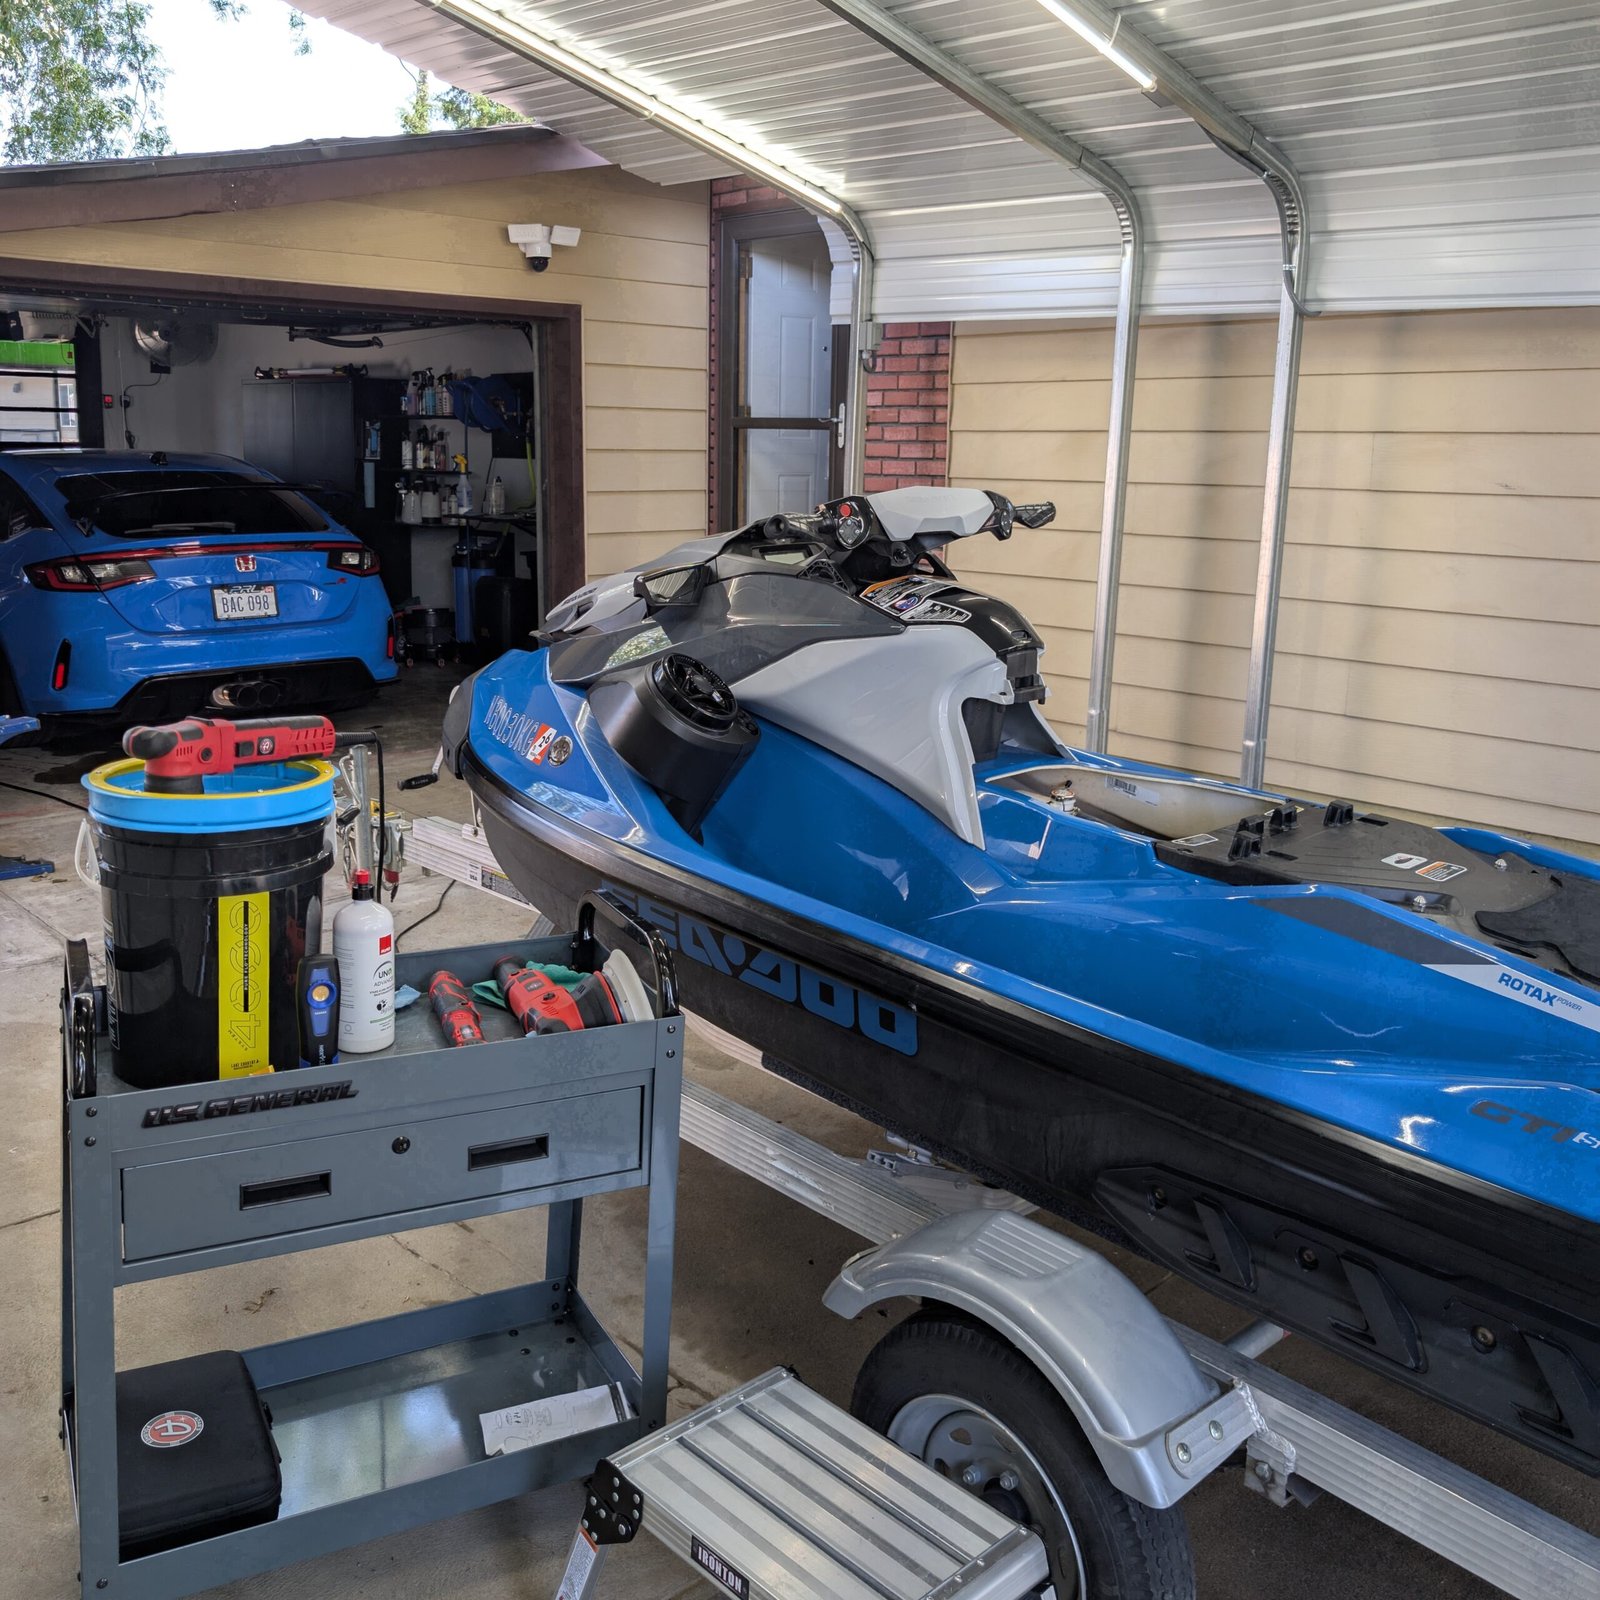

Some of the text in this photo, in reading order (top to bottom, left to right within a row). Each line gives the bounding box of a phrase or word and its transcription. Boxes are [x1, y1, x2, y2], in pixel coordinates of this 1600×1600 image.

[222, 594, 270, 613] BAC 098
[1498, 972, 1582, 1011] ROTAX POWER
[203, 1080, 360, 1119] GENERAL
[698, 1546, 742, 1594] IRONTON
